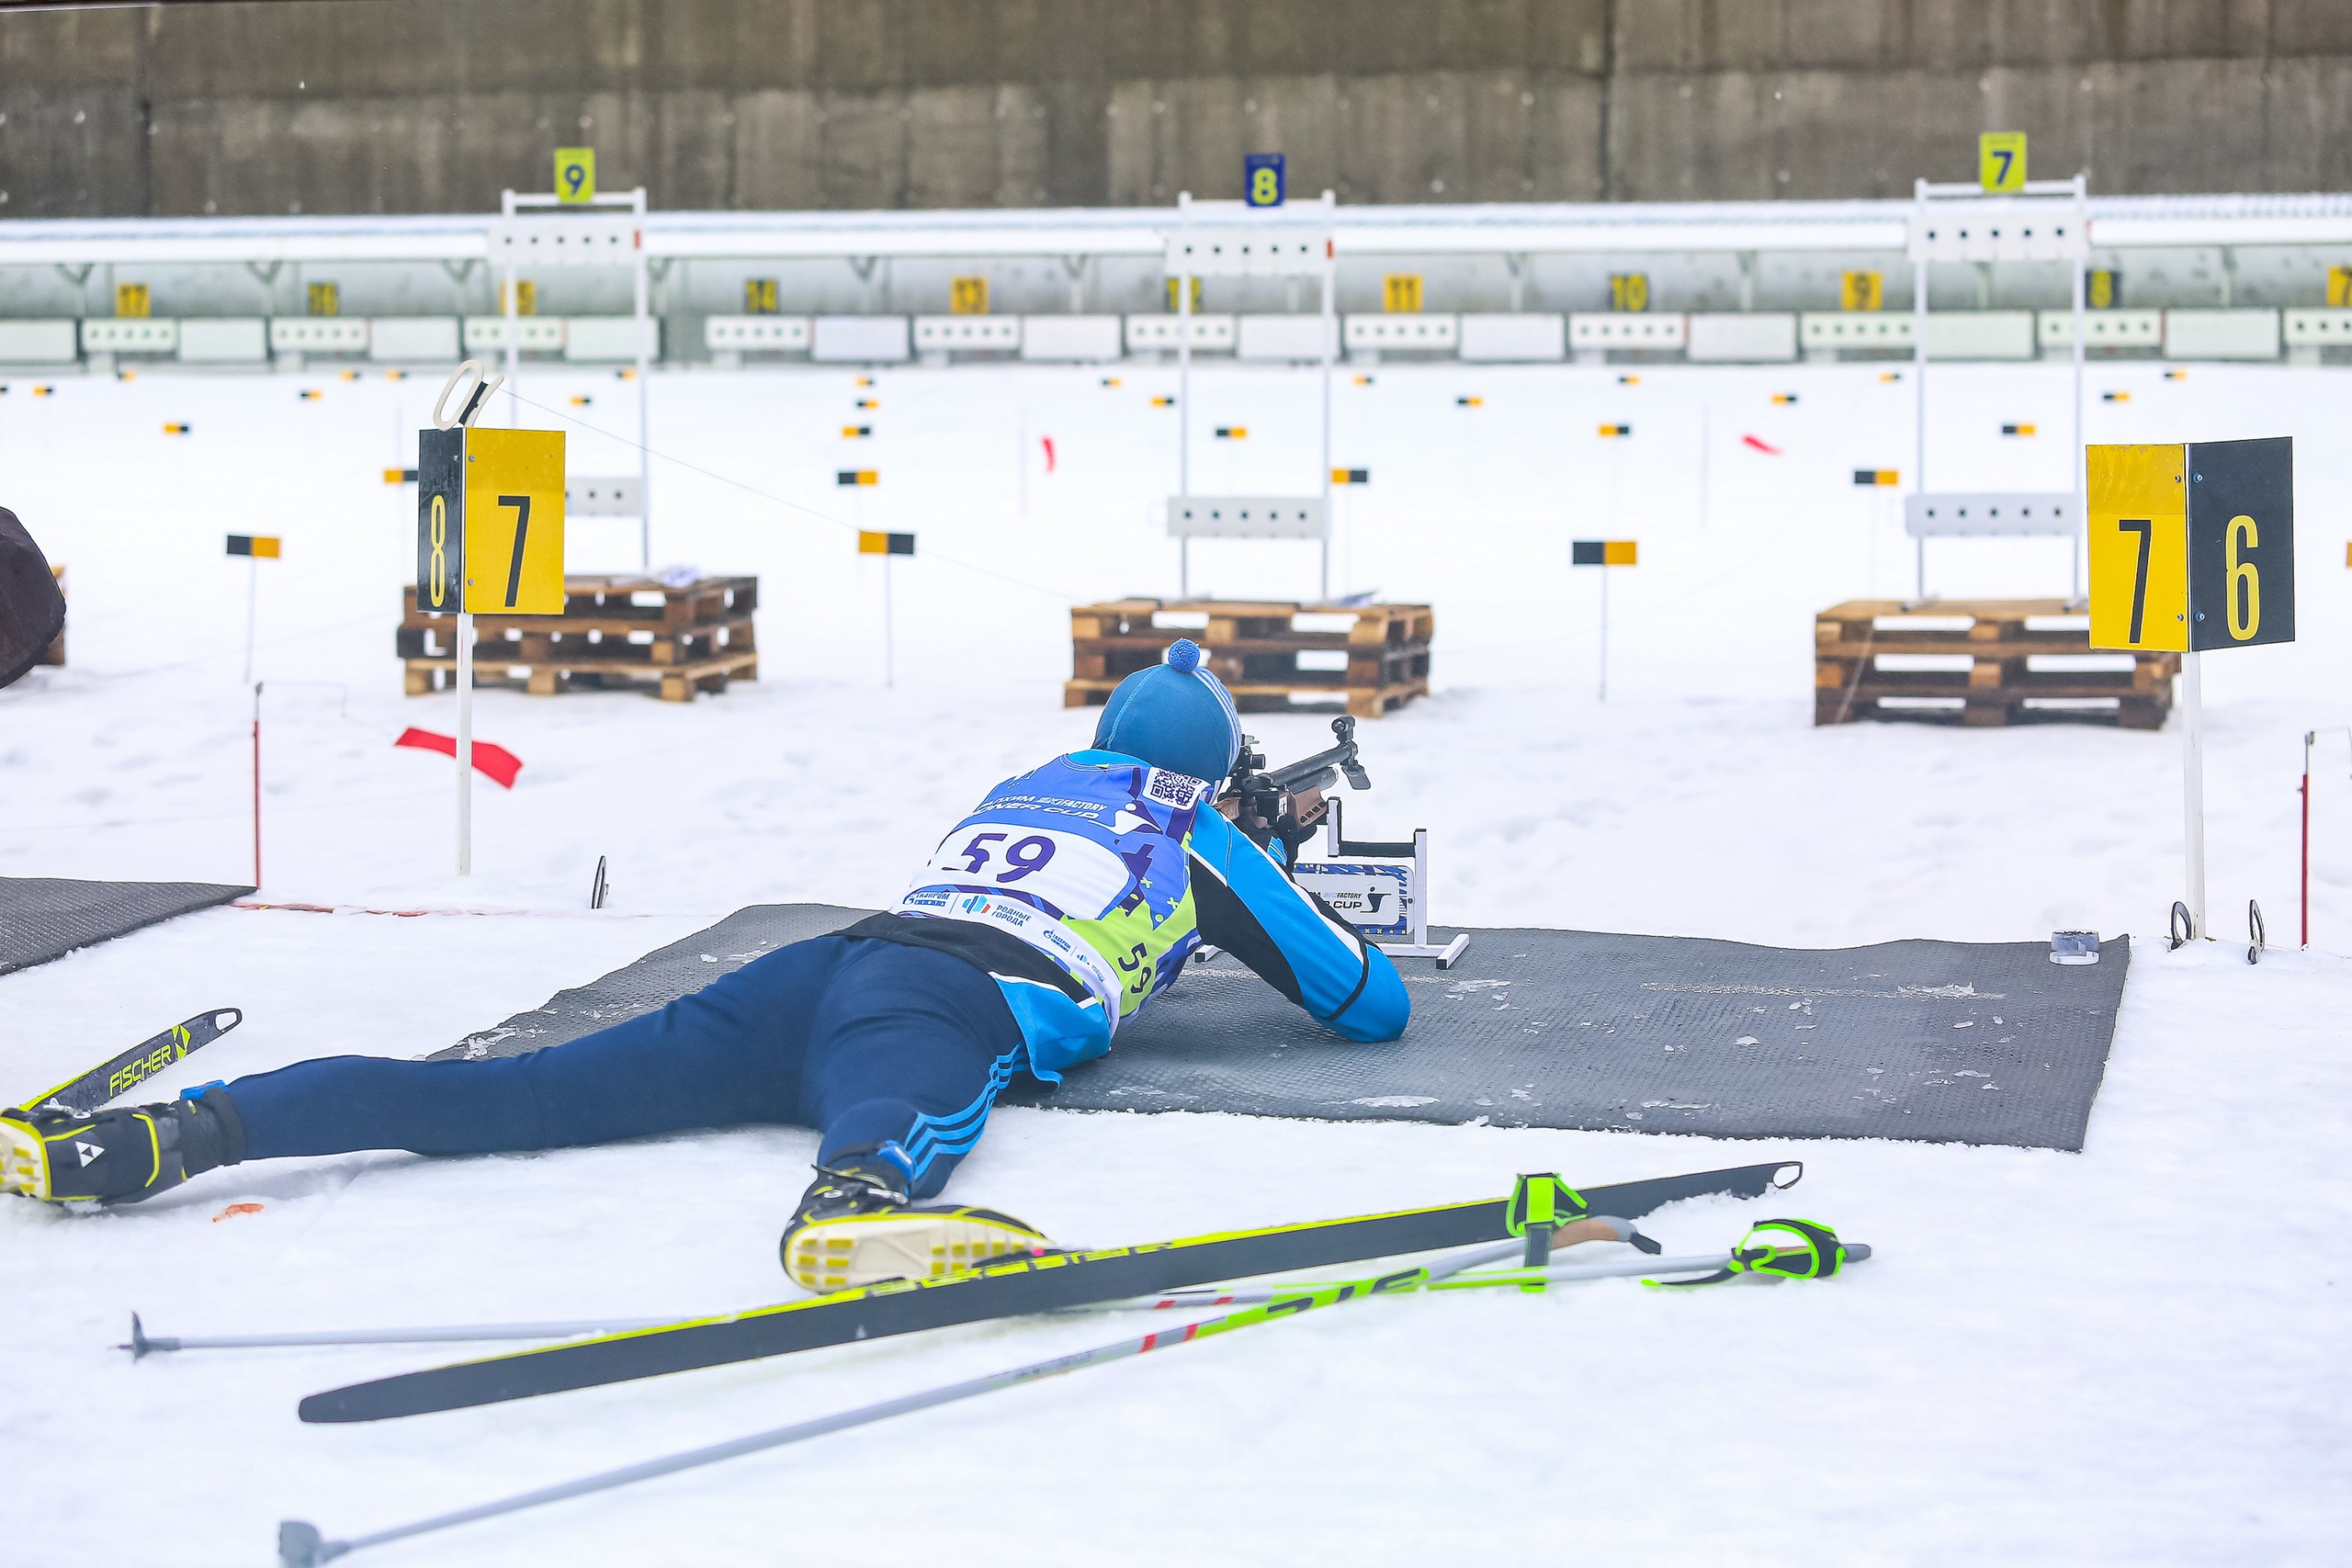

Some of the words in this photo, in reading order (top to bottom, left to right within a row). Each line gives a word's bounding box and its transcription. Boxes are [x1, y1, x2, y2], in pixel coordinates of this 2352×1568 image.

[564, 164, 585, 197] 9
[1252, 167, 1278, 205] 8
[1992, 150, 2013, 185] 7
[1611, 275, 1646, 311] 10
[430, 494, 447, 607] 8
[498, 495, 531, 607] 7
[2119, 519, 2152, 644] 7
[2225, 514, 2261, 641] 6
[1043, 807, 1100, 819] CUP
[941, 832, 1056, 883] 59
[991, 911, 1024, 928] ГОРОДА
[996, 905, 1032, 922] РОДНЫЕ
[1333, 900, 1362, 908] CUP
[1117, 942, 1152, 994] 59
[109, 1044, 173, 1098] FISCHER
